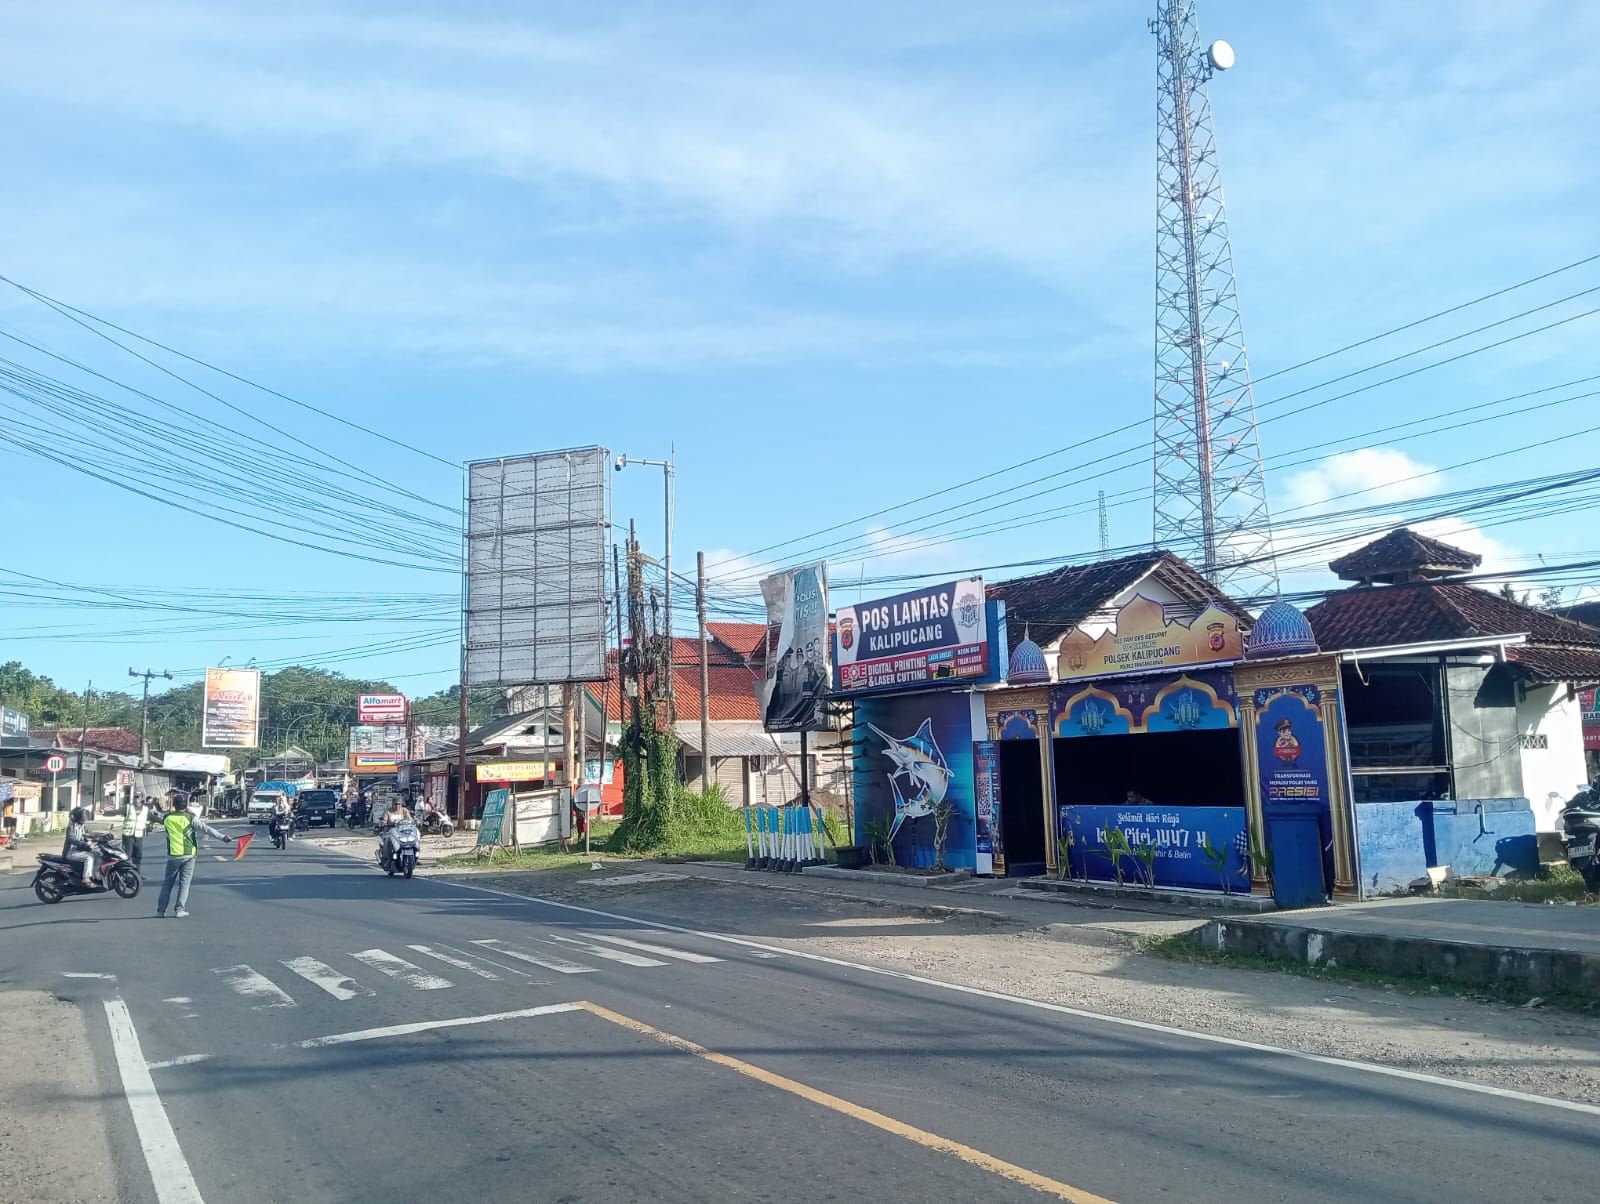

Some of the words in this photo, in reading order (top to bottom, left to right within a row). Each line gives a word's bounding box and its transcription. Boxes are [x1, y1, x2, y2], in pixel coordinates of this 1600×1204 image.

[862, 606, 889, 632] POS
[893, 592, 949, 626] LANTAS
[870, 624, 943, 651] KALIPUCANG
[1103, 652, 1130, 665] POLSEK
[1131, 646, 1181, 661] KALIPUCANG
[868, 662, 893, 676] DIGITAL
[894, 656, 927, 672] PRINTING
[896, 669, 927, 683] CUTTING
[1269, 786, 1320, 797] PRESISI
[1117, 812, 1143, 825] Selamat
[1145, 813, 1160, 823] Hari
[1162, 813, 1180, 827] Raya
[1174, 850, 1192, 859] Batin
